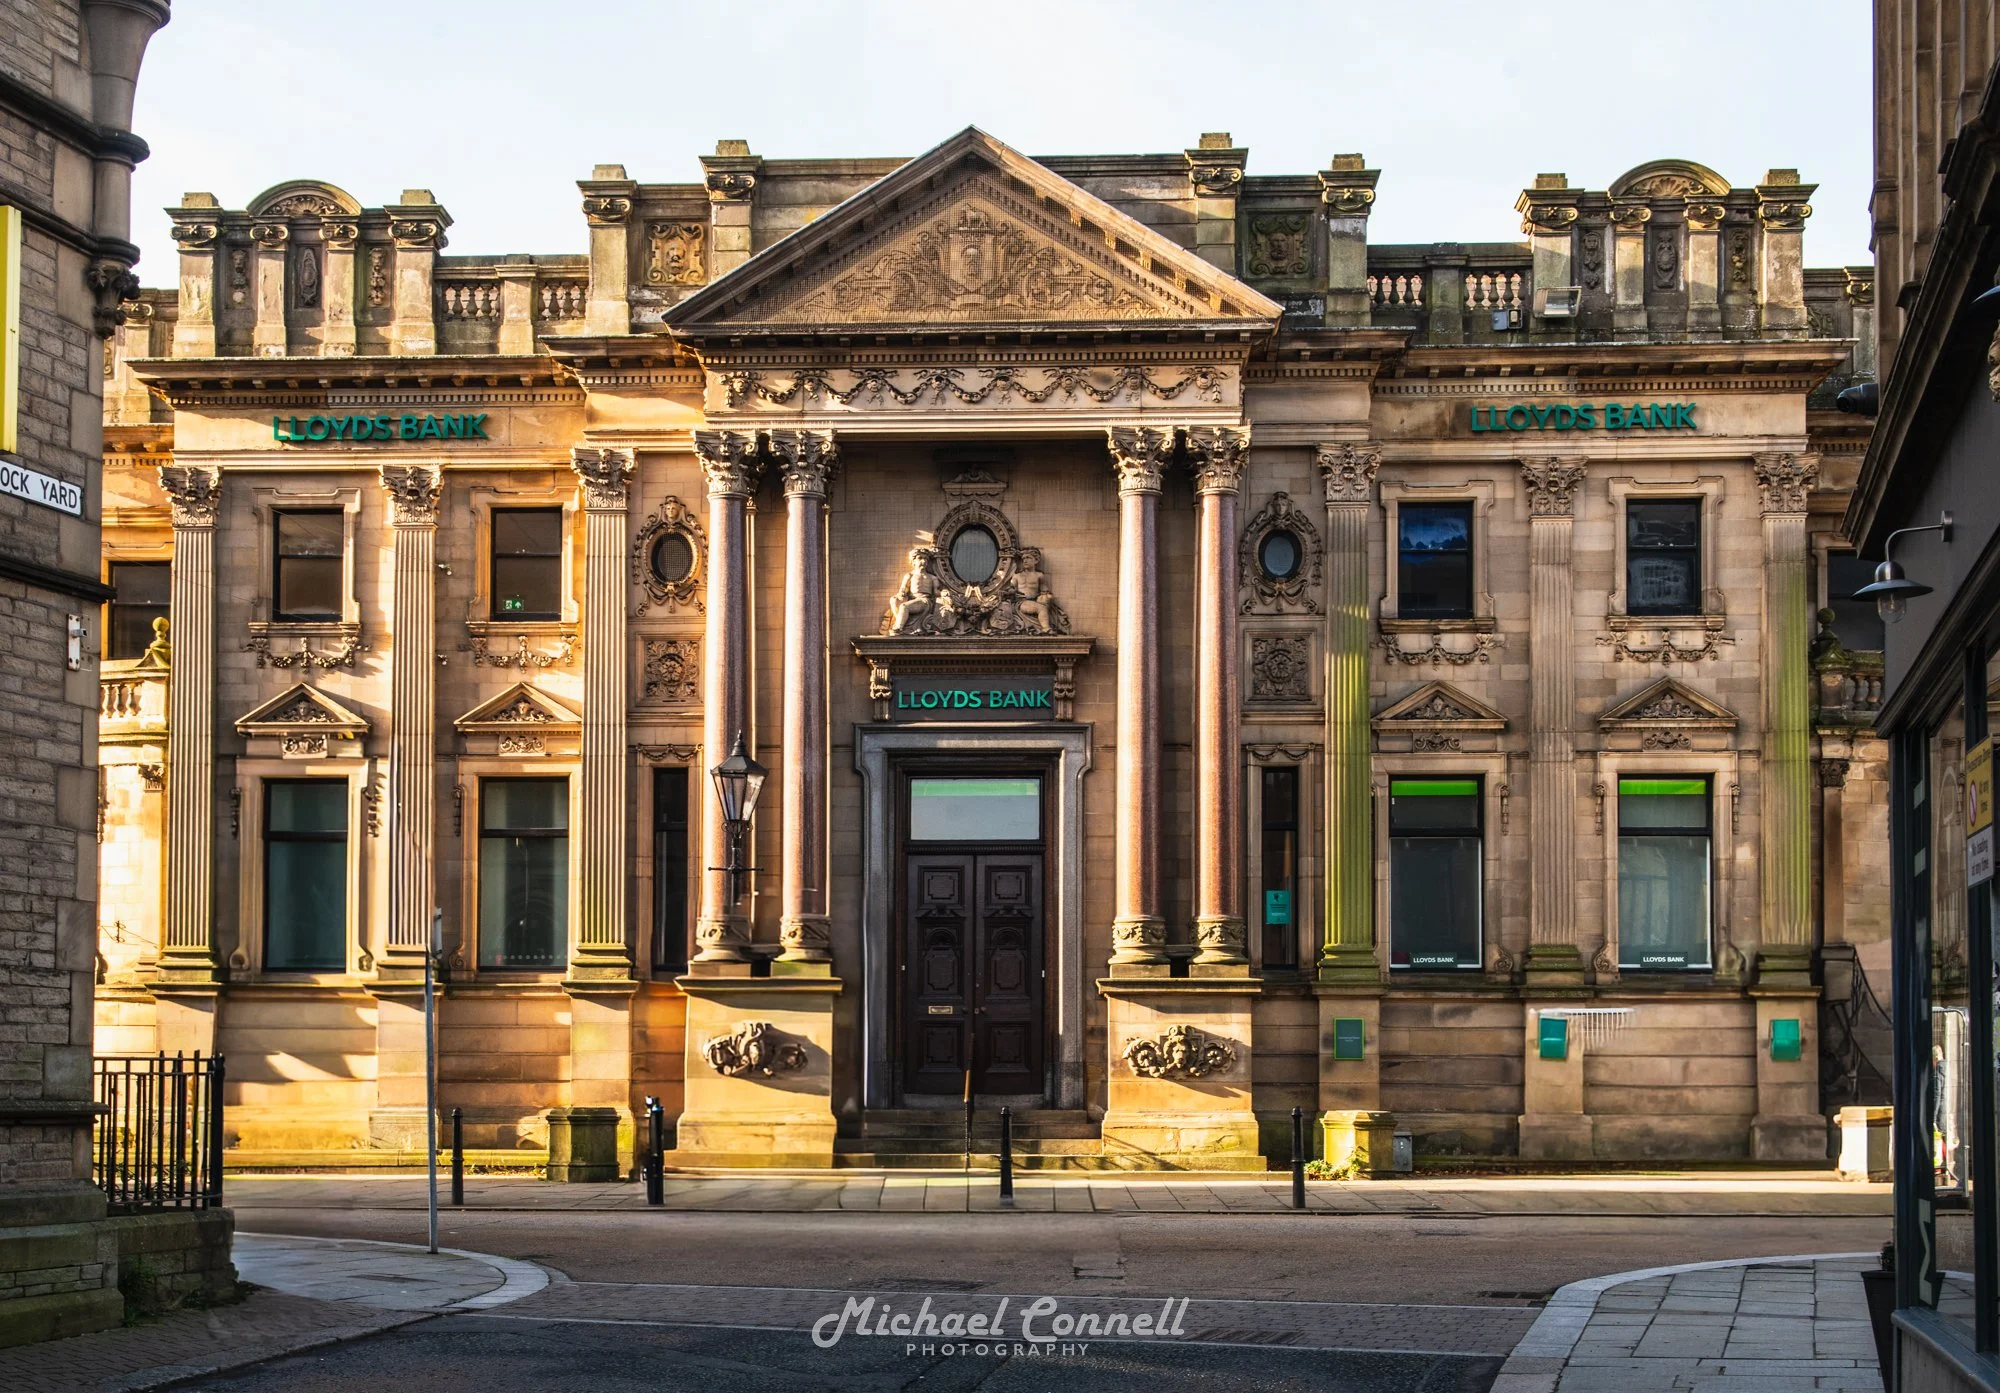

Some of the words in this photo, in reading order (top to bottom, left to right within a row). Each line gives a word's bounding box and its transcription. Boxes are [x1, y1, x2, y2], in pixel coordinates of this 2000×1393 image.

[273, 415, 393, 441] LLOYDS
[400, 413, 489, 440] BANK
[1471, 404, 1596, 431] LLOYDS
[1605, 402, 1697, 430] BANK
[0, 466, 30, 495] OCK
[40, 478, 78, 509] YARD
[898, 690, 983, 709] LLOYDS
[989, 689, 1051, 708] BANK
